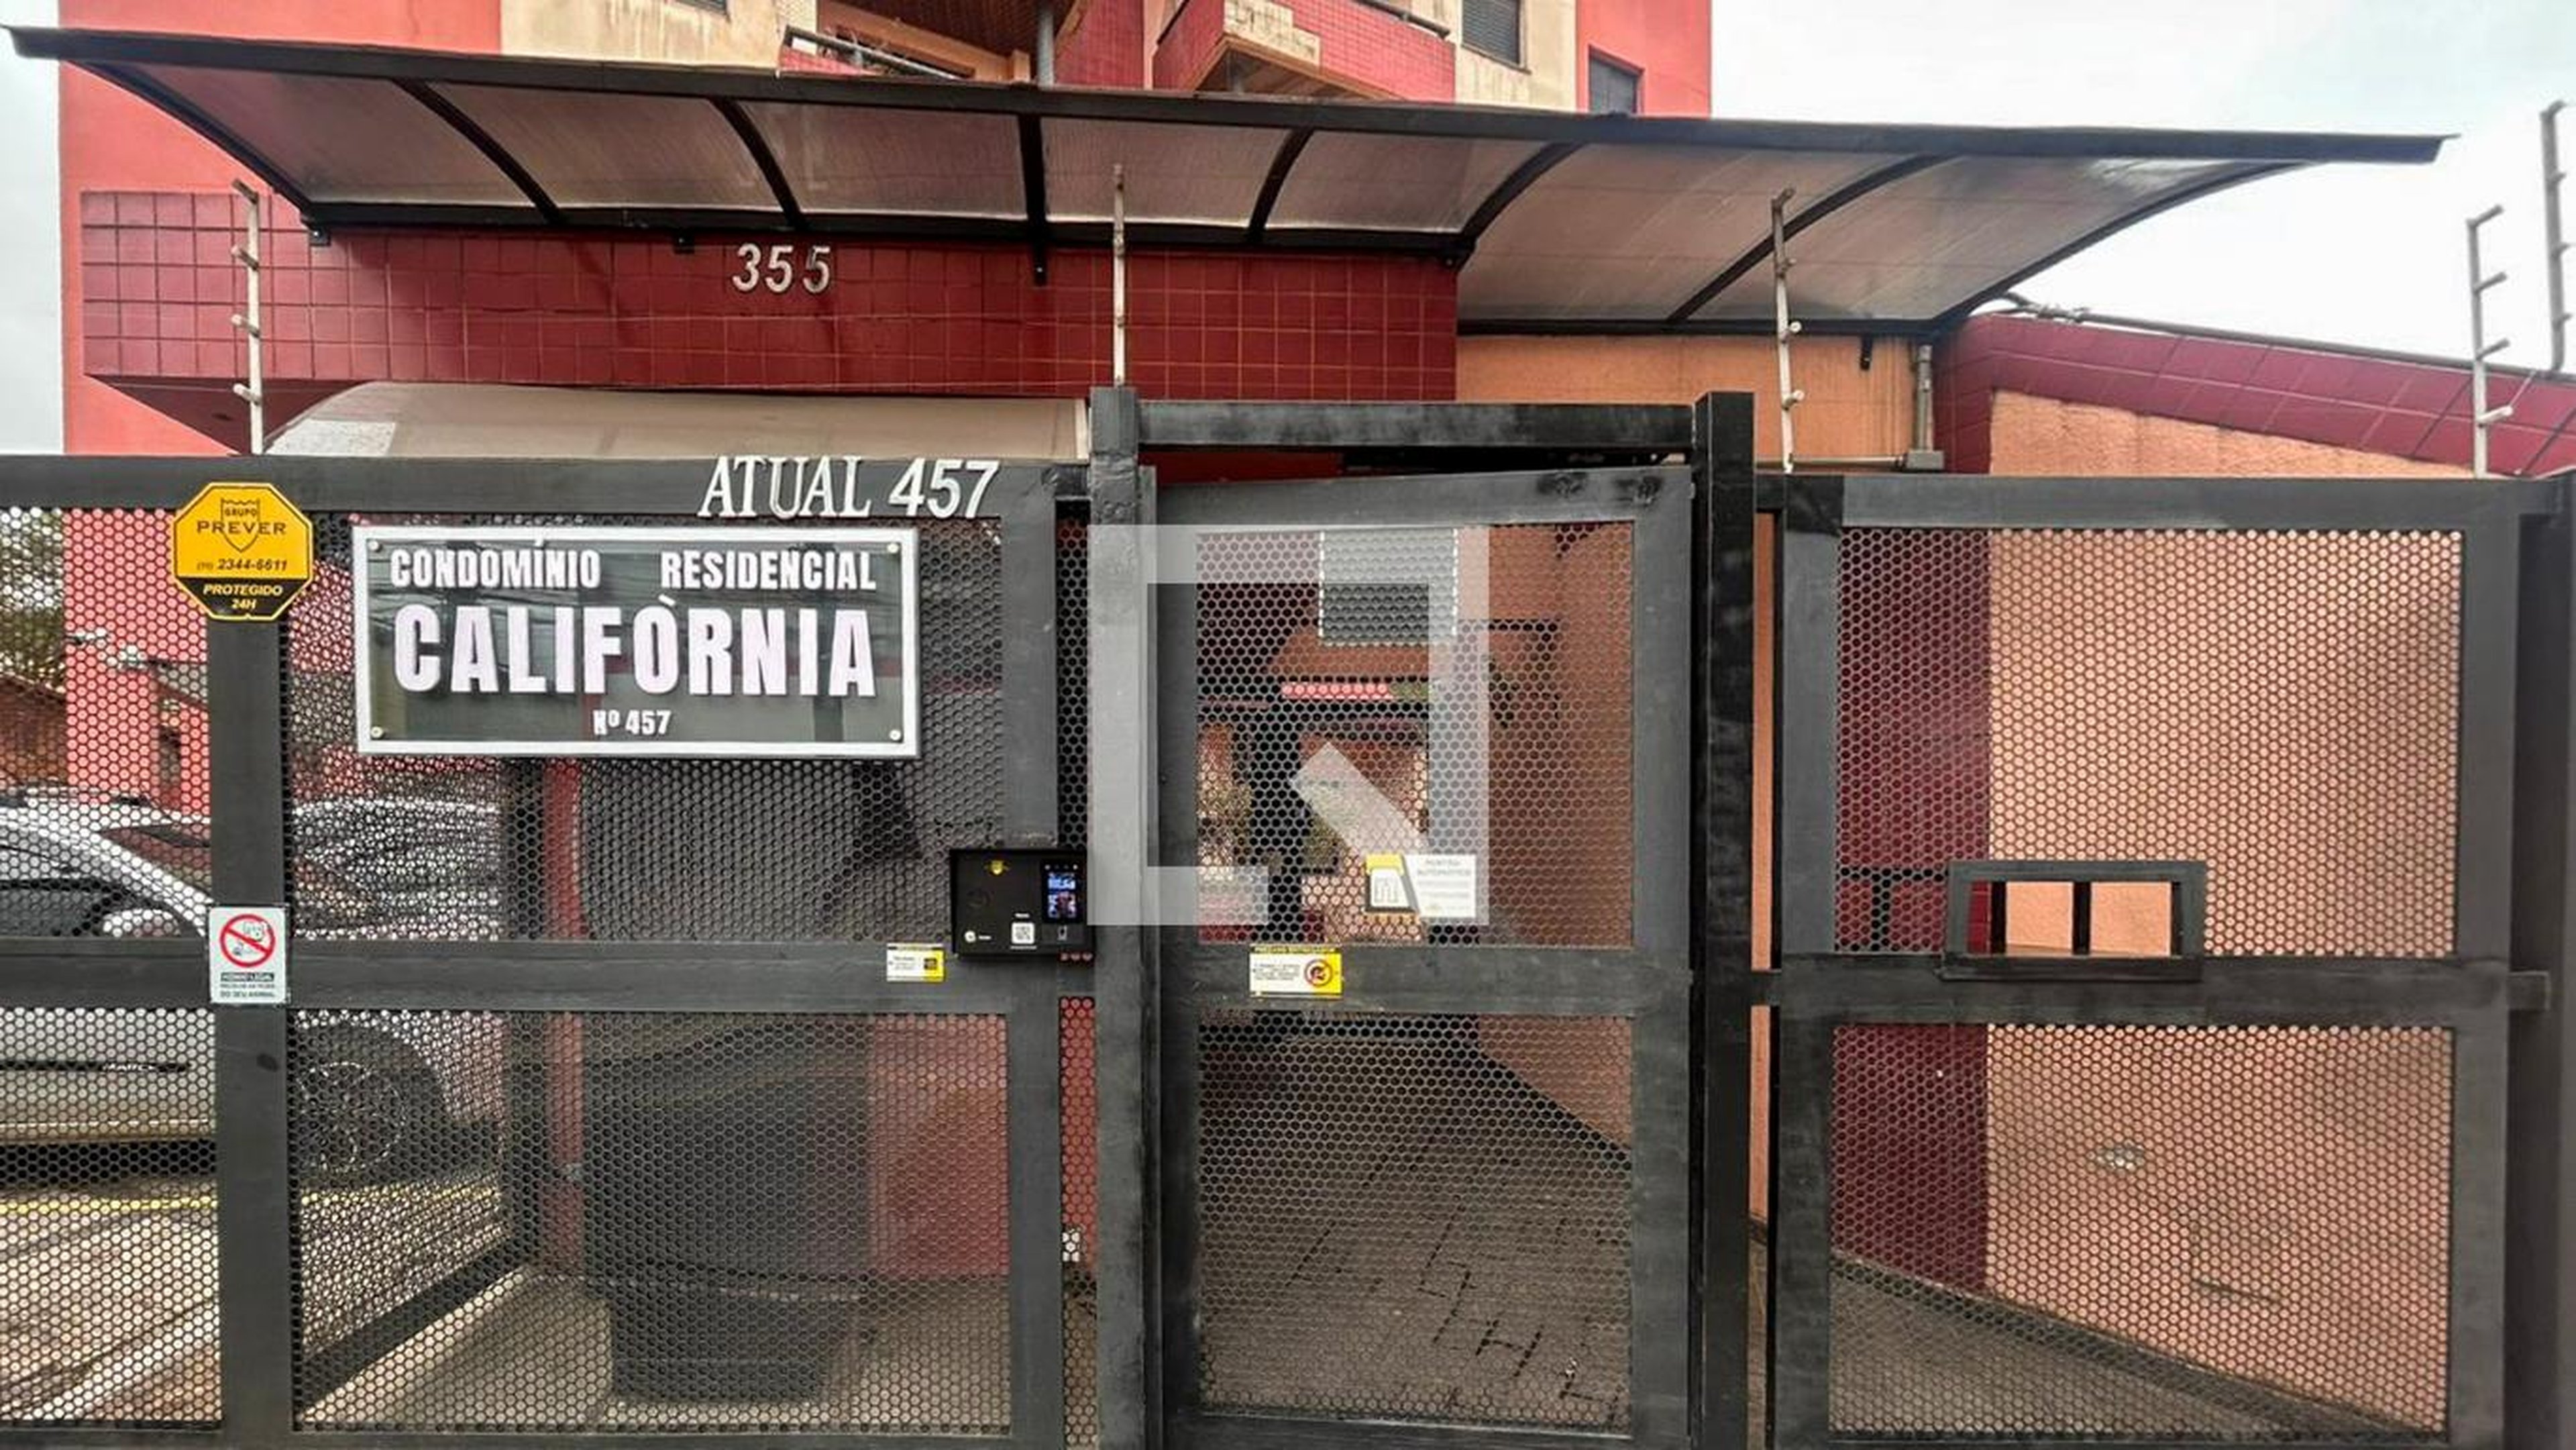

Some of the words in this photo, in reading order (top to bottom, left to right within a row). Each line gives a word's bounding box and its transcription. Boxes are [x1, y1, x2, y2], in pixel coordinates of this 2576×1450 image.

[732, 243, 831, 293] 355
[697, 455, 871, 519] ATUAL
[888, 457, 1000, 519] 457
[224, 507, 258, 517] GRUPO
[197, 521, 286, 535] PREVER
[390, 538, 600, 588] CONDOMÍNIO
[661, 550, 877, 590] RESIDENCIAL
[203, 584, 283, 597] PROTEGIDO
[231, 599, 257, 610] 24H
[625, 709, 671, 735] 457
